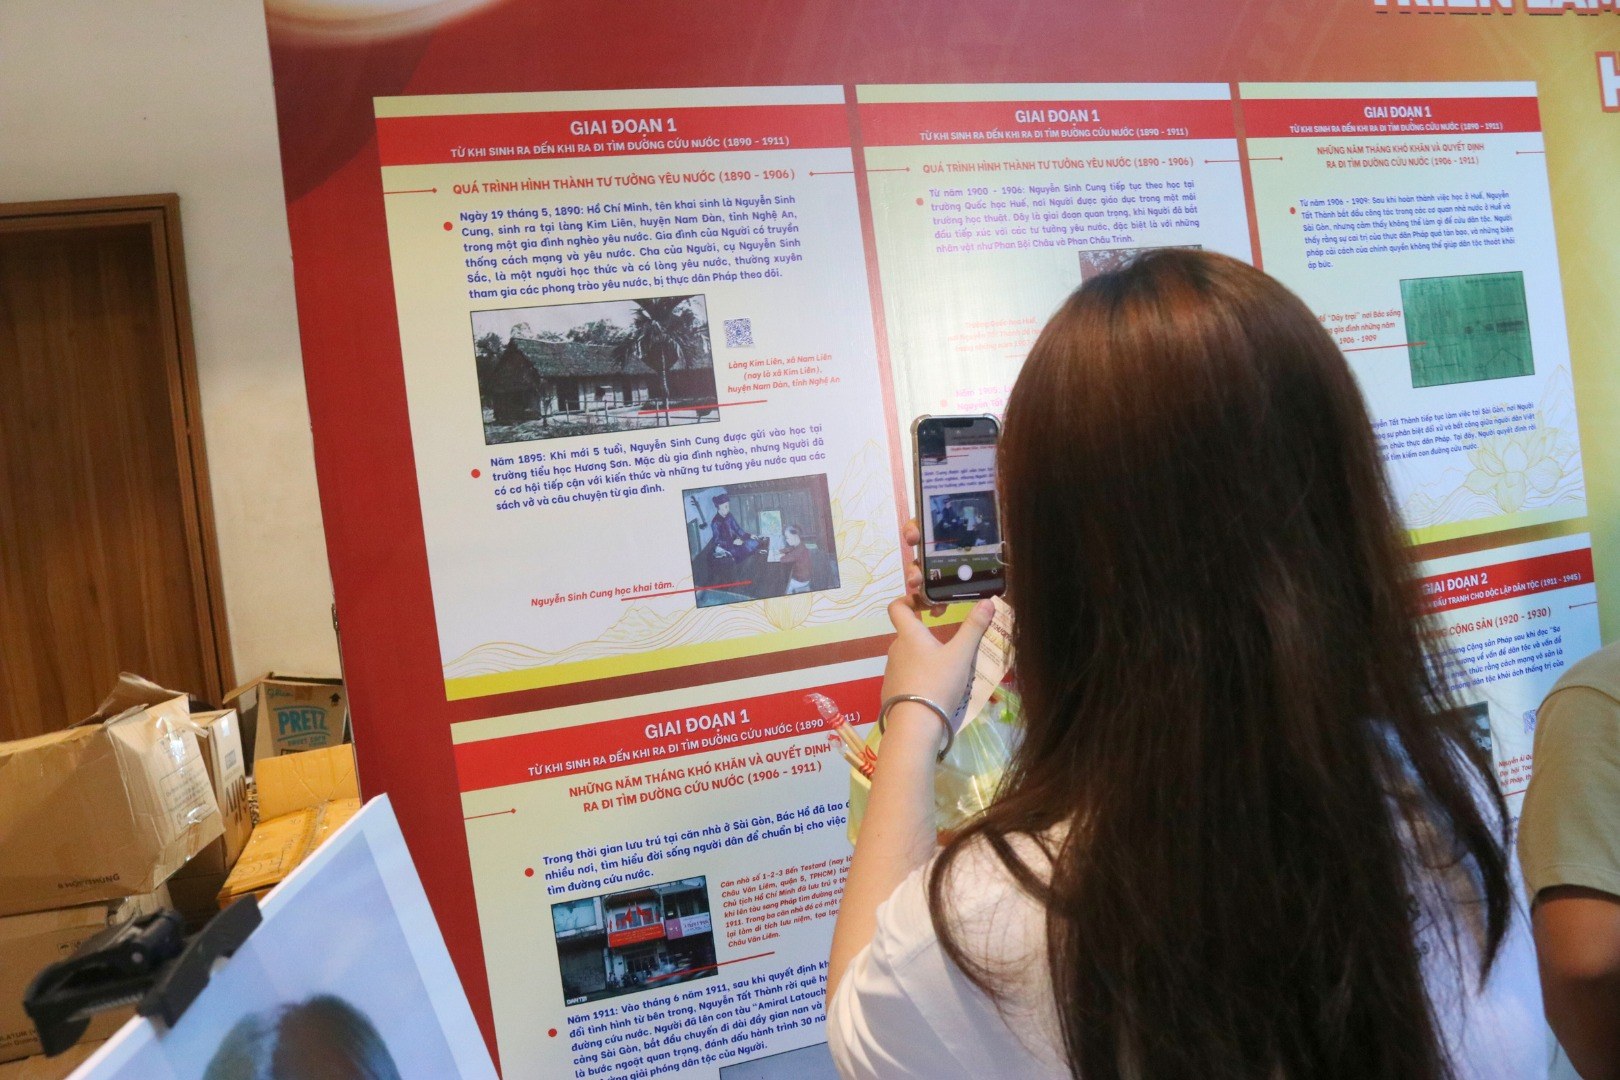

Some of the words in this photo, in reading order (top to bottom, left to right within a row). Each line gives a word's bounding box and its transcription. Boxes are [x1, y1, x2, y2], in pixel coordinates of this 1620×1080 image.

[1014, 109, 1045, 123] GIAI
[1047, 109, 1089, 126] ĐOẠN
[1091, 109, 1100, 122] 1
[1363, 106, 1388, 118] GIAI
[1389, 105, 1423, 121] ĐOẠN
[1424, 105, 1432, 117] 1
[570, 120, 607, 135] GIAI
[611, 118, 662, 137] ĐOẠN
[666, 117, 677, 132] 1
[450, 145, 465, 157] TỪ
[467, 147, 486, 157] KHI
[488, 146, 514, 156] SINH
[516, 146, 531, 154] RA
[533, 140, 555, 154] ĐẾN
[556, 143, 575, 153] KHI
[577, 143, 591, 152] RA
[593, 142, 604, 151] ĐI
[606, 139, 625, 151] TÌM
[626, 138, 665, 150] ĐƯỜNG
[666, 137, 689, 148] CỨU
[691, 135, 720, 147] NƯỚC
[723, 137, 752, 148] (1890
[761, 135, 789, 146] 1911)
[922, 160, 944, 173] QUÁ
[945, 160, 975, 172] TRÌNH
[976, 159, 1001, 171] HÌNH
[1002, 158, 1036, 170] THÀNH
[1036, 159, 1050, 169] TƯ
[1051, 156, 1085, 169] TƯỞNG
[1085, 157, 1104, 168] YÊU
[1104, 155, 1131, 168] NƯỚC
[1133, 157, 1159, 168] (1890
[1167, 156, 1193, 167] 1906)
[452, 179, 479, 194] QUÁ
[481, 179, 518, 192] TRÌNH
[520, 177, 550, 191] HÌNH
[552, 175, 594, 189] THÀNH
[595, 175, 612, 187] TƯ
[613, 172, 656, 186] TƯỞNG
[657, 171, 680, 184] YÊU
[682, 169, 715, 183] NƯỚC
[718, 170, 751, 183] (1890
[762, 169, 794, 180] 1906)
[459, 210, 488, 223] Ngày
[491, 209, 503, 219] 19
[506, 207, 538, 219] tháng
[541, 207, 551, 217] 5,
[554, 205, 583, 216] 1890:
[586, 202, 601, 214] Hồ
[603, 202, 620, 213] Chí
[623, 202, 652, 212] Minh,
[654, 201, 672, 210] tên
[674, 199, 696, 209] khai
[699, 198, 719, 208] sinh
[722, 197, 732, 207] là
[734, 194, 771, 208] Nguyễn
[774, 195, 795, 204] Sinh
[490, 456, 514, 467] Năm
[518, 453, 545, 464] 1895:
[549, 449, 566, 460] Khi
[570, 447, 589, 458] mới
[593, 447, 599, 456] 5
[603, 442, 626, 455] tuổi,
[629, 438, 666, 453] Nguyễn
[670, 437, 691, 447] Sinh
[694, 436, 719, 446] Cung
[723, 433, 746, 443] được
[750, 429, 765, 441] gửi
[769, 427, 785, 437] vào
[789, 426, 805, 436] học
[809, 424, 821, 434] tại
[531, 592, 565, 607] Nguyễn
[567, 591, 587, 602] Sinh
[589, 589, 612, 598] Cung
[615, 588, 631, 597] học
[633, 582, 652, 593] khai
[654, 581, 675, 590] tâm.
[1446, 574, 1479, 591] ĐOẠN
[1480, 572, 1488, 584] 2
[1450, 623, 1474, 637] CỘNG
[1475, 617, 1492, 630] SẢN
[1494, 613, 1518, 628] (1920
[1527, 606, 1551, 620] 1930)
[278, 709, 326, 735] PRETZ
[644, 719, 681, 739] GIAI
[685, 710, 736, 732] ĐOẠN
[739, 708, 750, 723] 1
[568, 781, 613, 797] NHỮNG
[614, 775, 642, 789] NĂM
[644, 768, 685, 784] THÁNG
[687, 760, 712, 777] KHÓ
[714, 756, 746, 772] KHĂN
[747, 752, 763, 766] VÀ
[765, 745, 801, 763] QUYẾT
[804, 742, 831, 757] ĐỊNH
[583, 801, 599, 812] RA
[601, 798, 613, 809] ĐI
[615, 792, 637, 806] TÌM
[639, 786, 682, 802] ĐƯỜNG
[684, 779, 709, 794] CỨU
[711, 774, 744, 789] NƯỚC
[747, 769, 779, 785] (1906
[791, 760, 821, 775] 1911)
[547, 885, 565, 895] tìm
[567, 879, 601, 891] đường
[603, 873, 622, 884] cứu
[624, 868, 653, 880] nước.
